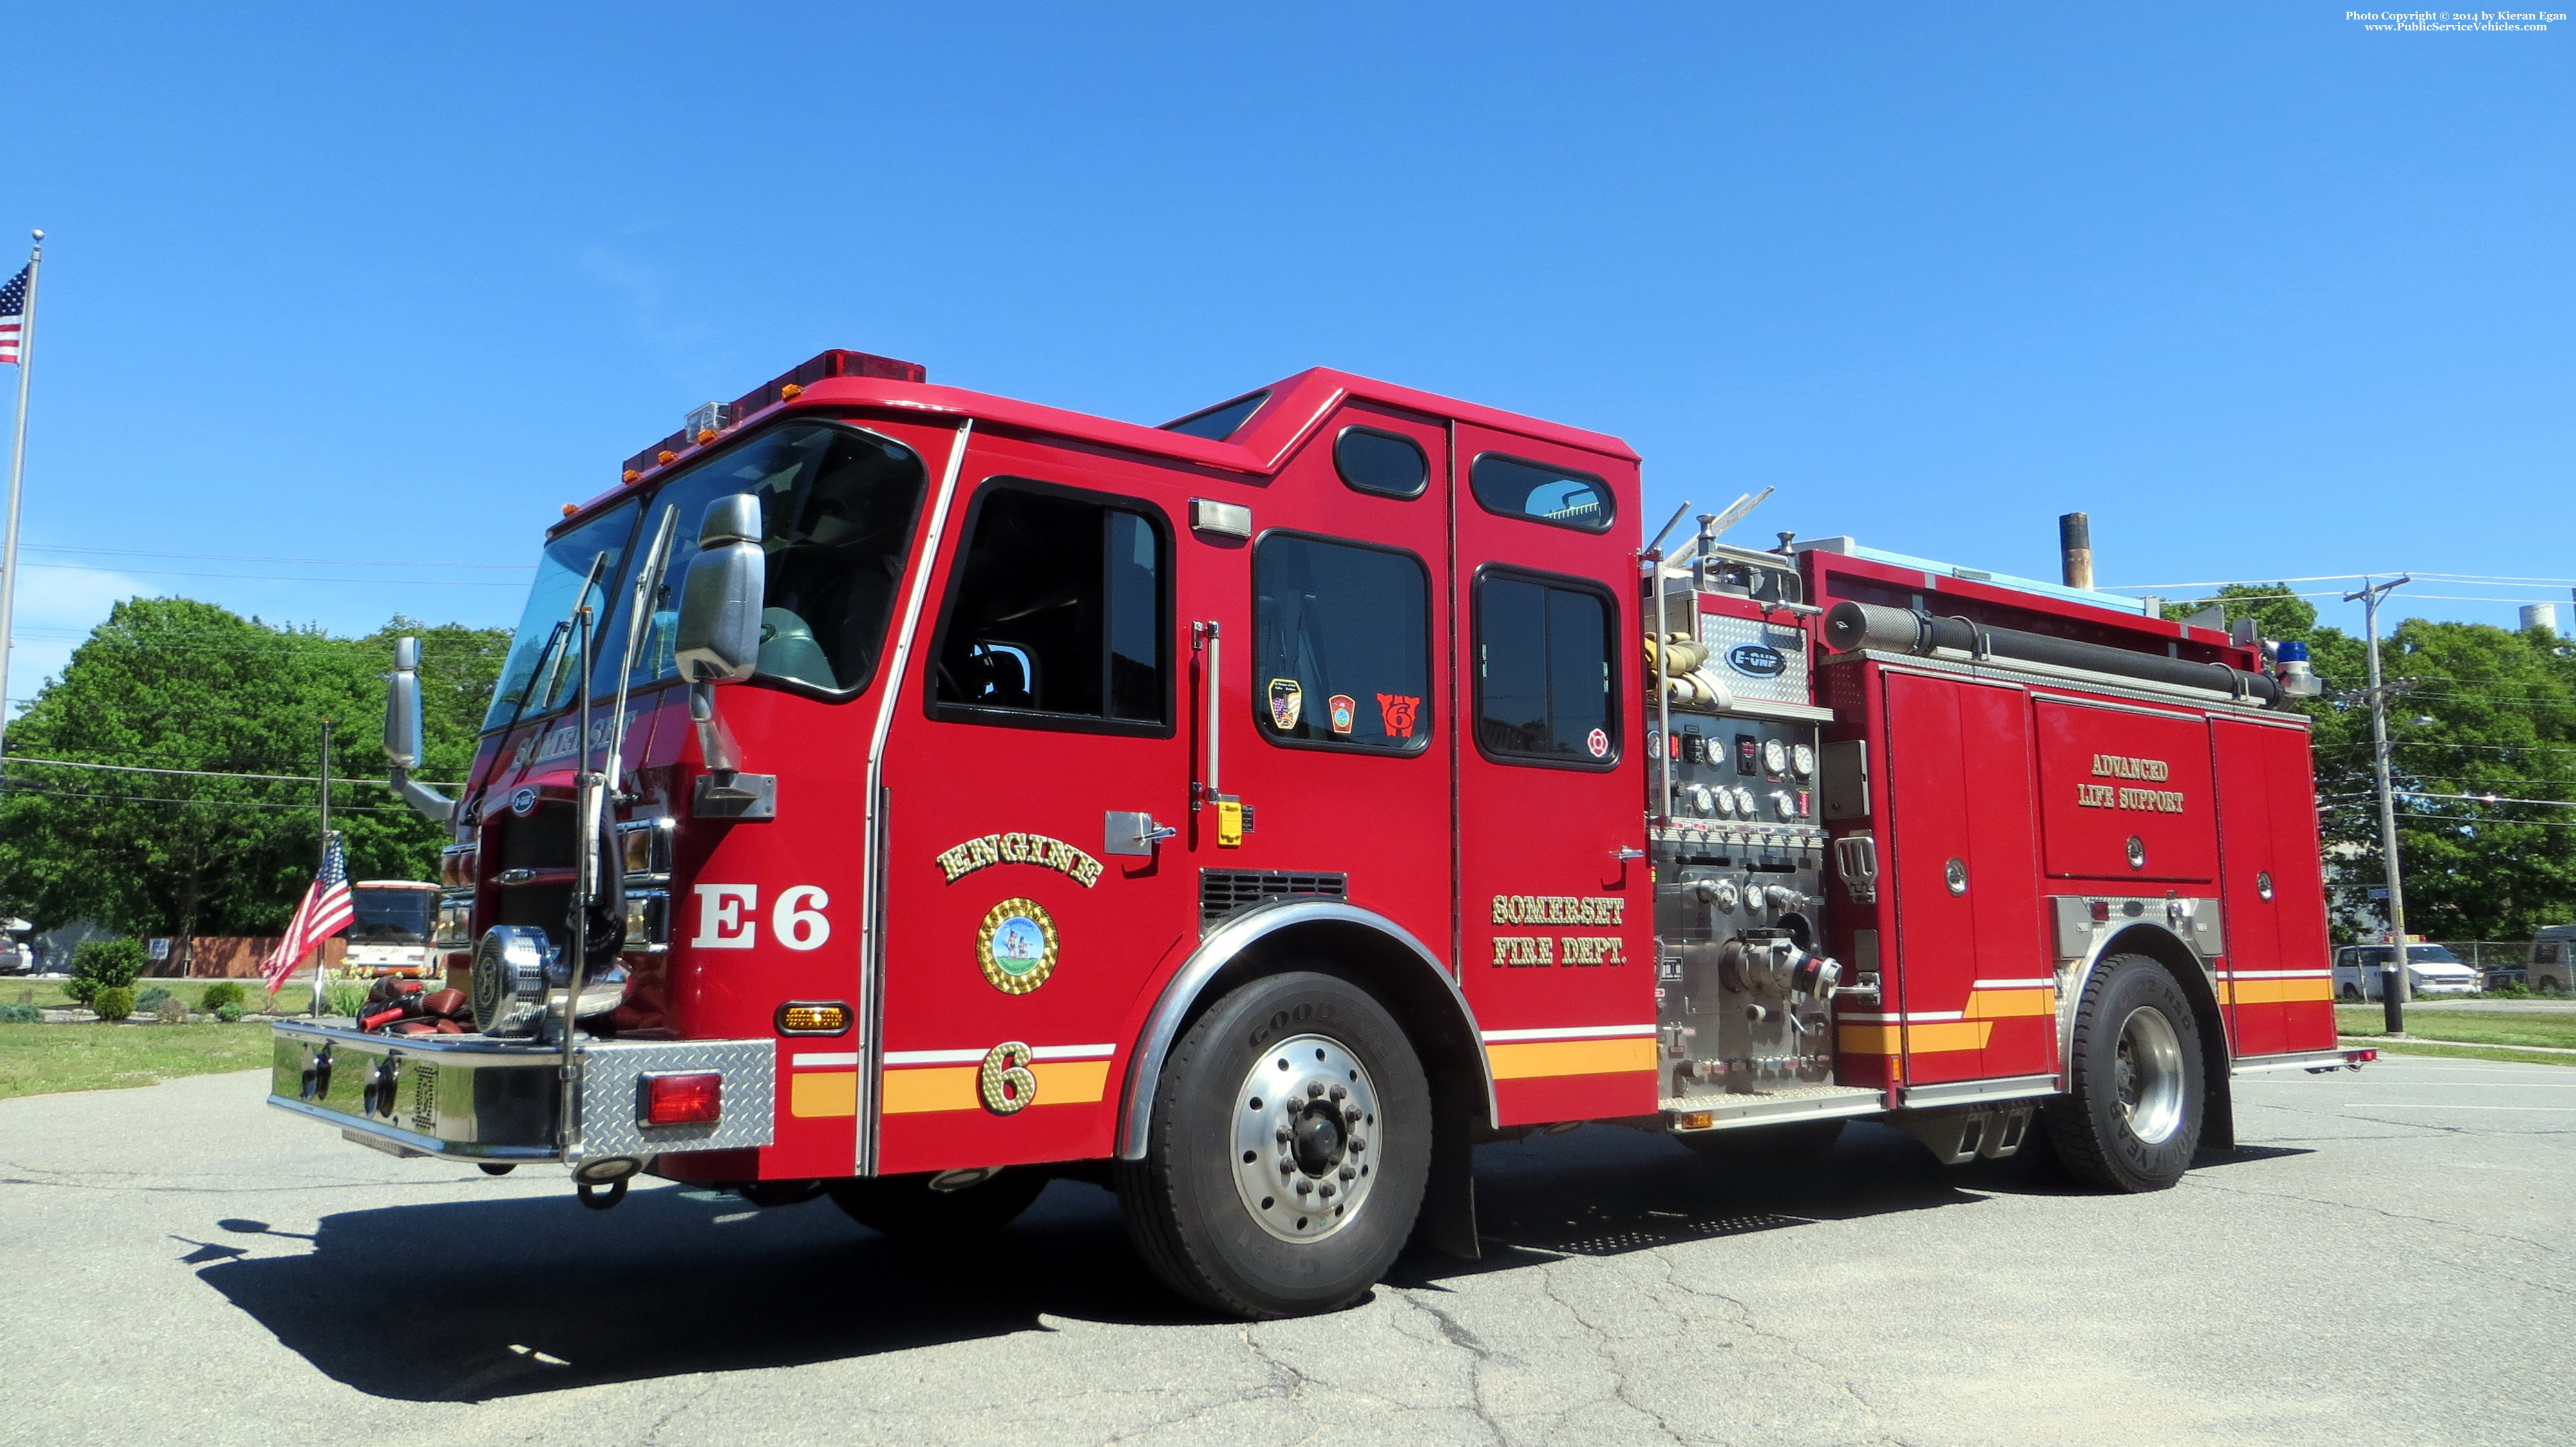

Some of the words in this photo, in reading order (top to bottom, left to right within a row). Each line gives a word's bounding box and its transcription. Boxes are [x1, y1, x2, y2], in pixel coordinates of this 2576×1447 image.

[1734, 650, 1778, 668] E-ONE
[2092, 753, 2169, 782] ADVANCED
[2078, 784, 2114, 808] LIFE
[2119, 787, 2184, 814] SUPPORT
[936, 832, 1105, 889] ENGINE
[1492, 894, 1625, 925] SOMERSET
[1492, 937, 1553, 966] FIRE
[1560, 937, 1627, 966] DEPT.
[980, 1041, 1036, 1116] 6
